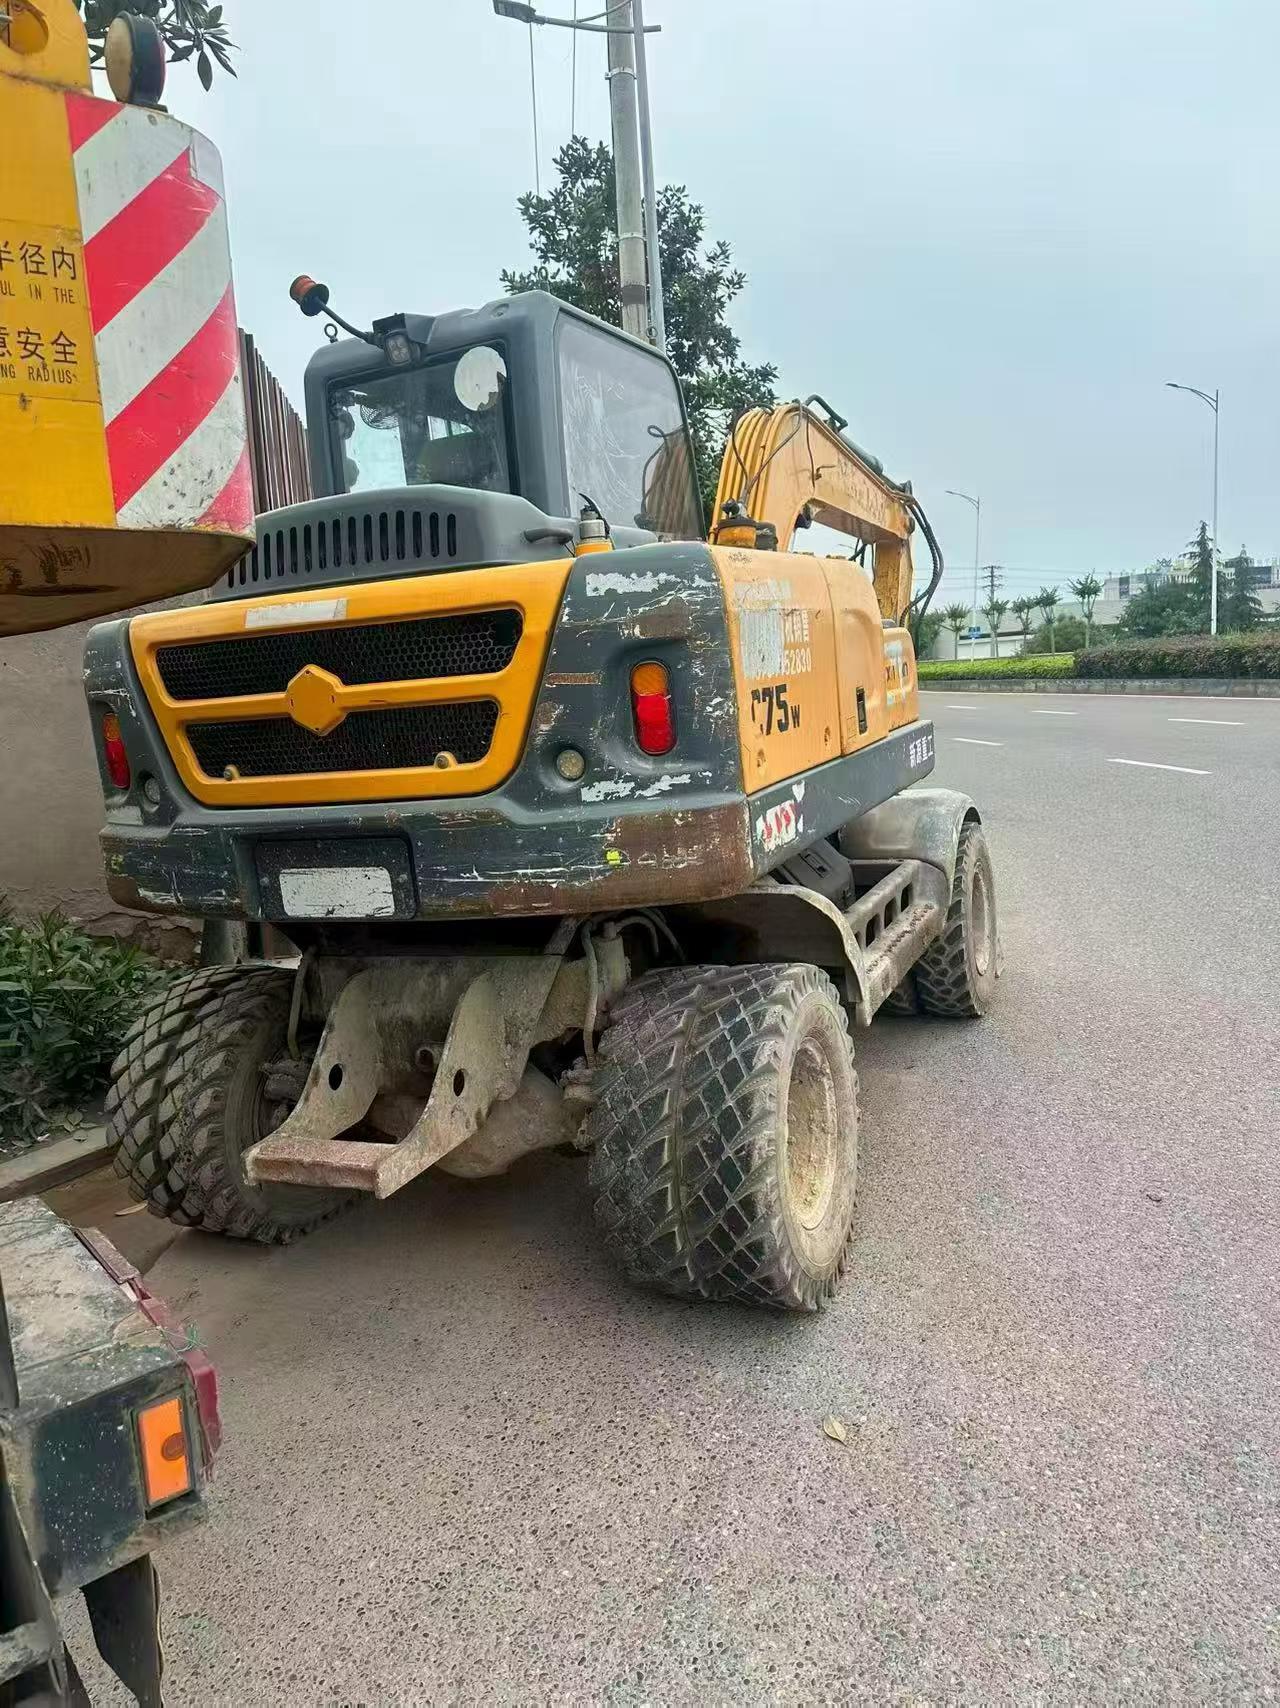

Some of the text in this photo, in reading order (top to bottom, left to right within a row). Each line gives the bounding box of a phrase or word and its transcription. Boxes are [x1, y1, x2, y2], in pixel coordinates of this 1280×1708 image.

[29, 283, 42, 300] IN
[53, 286, 76, 304] THE
[27, 365, 73, 384] RADIUS
